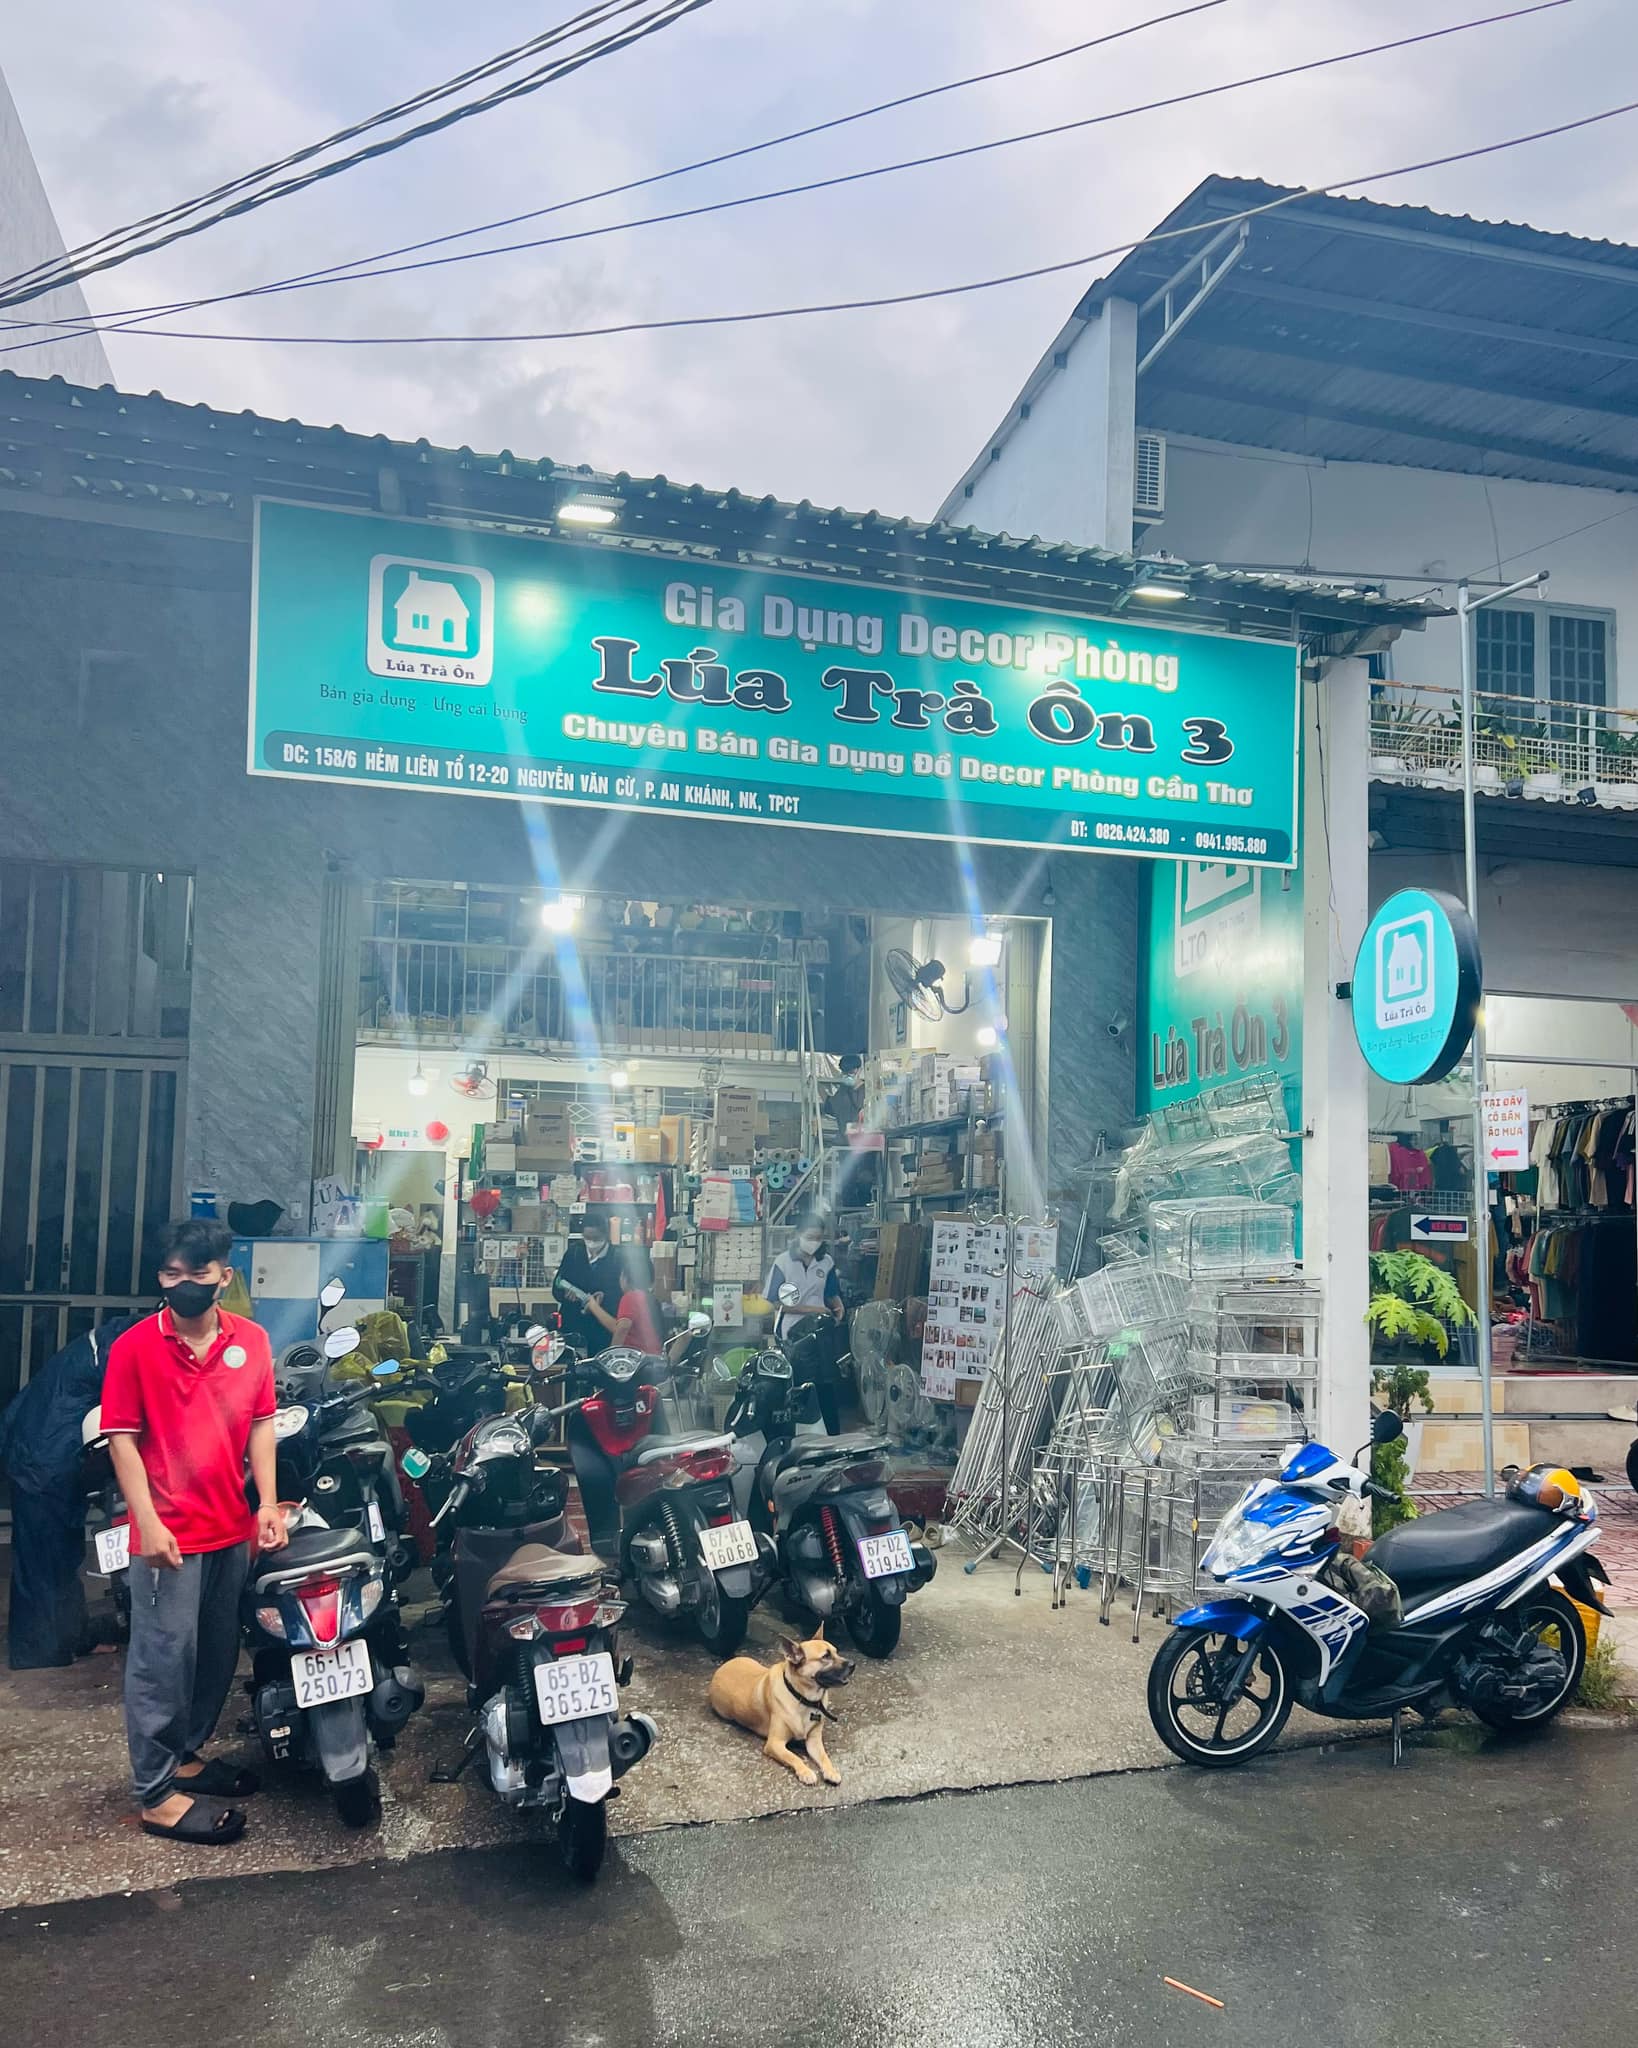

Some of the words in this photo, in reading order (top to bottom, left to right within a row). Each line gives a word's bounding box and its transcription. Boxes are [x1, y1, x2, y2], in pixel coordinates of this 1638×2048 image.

[664, 582, 745, 632] Gia
[762, 594, 884, 656] Dụng
[899, 612, 1032, 670] Decor
[1043, 632, 1179, 692] Phòng
[386, 658, 415, 674] Lúa
[420, 663, 447, 677] Trà
[453, 664, 475, 680] Ôn
[320, 684, 347, 700] Bán
[353, 690, 374, 706] gia
[380, 692, 416, 711] dụng
[468, 703, 487, 715] cái
[494, 702, 528, 724] bụng
[592, 637, 793, 714] Lúa
[821, 665, 999, 736] Trà
[1027, 680, 1157, 754] Ôn
[1181, 717, 1235, 765] 3
[562, 713, 687, 750] Chuyên
[697, 728, 759, 759] Bán
[768, 736, 819, 764] Gia
[829, 743, 904, 775] Dụng
[913, 752, 953, 779] Đồ
[960, 757, 1045, 789] Decor
[1052, 766, 1139, 799] Phòng
[1147, 772, 1198, 801] Cần
[1205, 780, 1254, 806] Thơ
[283, 743, 309, 764] ĐC:
[315, 747, 357, 769] 158/6
[365, 747, 399, 773] HẺM
[406, 755, 439, 778] LIÊN
[446, 753, 464, 780] TỔ
[468, 763, 509, 785] 12-20
[517, 765, 574, 791] NGUYỄN
[580, 772, 609, 795] VĂN
[615, 775, 639, 800] CỪ,
[645, 781, 656, 800] P.
[660, 782, 680, 802] AN
[685, 783, 734, 810] KHÁNH,
[739, 791, 762, 812] NK,
[768, 793, 800, 814] TPCT
[1095, 822, 1170, 845] 0826.424.380
[1196, 832, 1267, 854] 0941.995.880
[1384, 1010, 1399, 1022] Lúa
[1400, 1006, 1413, 1018] Trà
[1153, 1025, 1189, 1089] Lúa
[1192, 1012, 1228, 1080] Trà
[1272, 988, 1289, 1062] 3
[1484, 1098, 1501, 1109] TẠI
[1503, 1095, 1522, 1106] ĐÂY
[1488, 1111, 1499, 1122] CÓ
[1488, 1126, 1500, 1137] ÁO
[1502, 1127, 1523, 1137] MƯA
[708, 1525, 746, 1548] 67-N1
[866, 1536, 902, 1557] 67-D2
[709, 1542, 755, 1567] 160.68
[866, 1552, 911, 1576] 319.45
[301, 1668, 367, 1703] 250.73
[547, 1660, 601, 1690] 65-B2
[544, 1684, 612, 1718] 365.25
